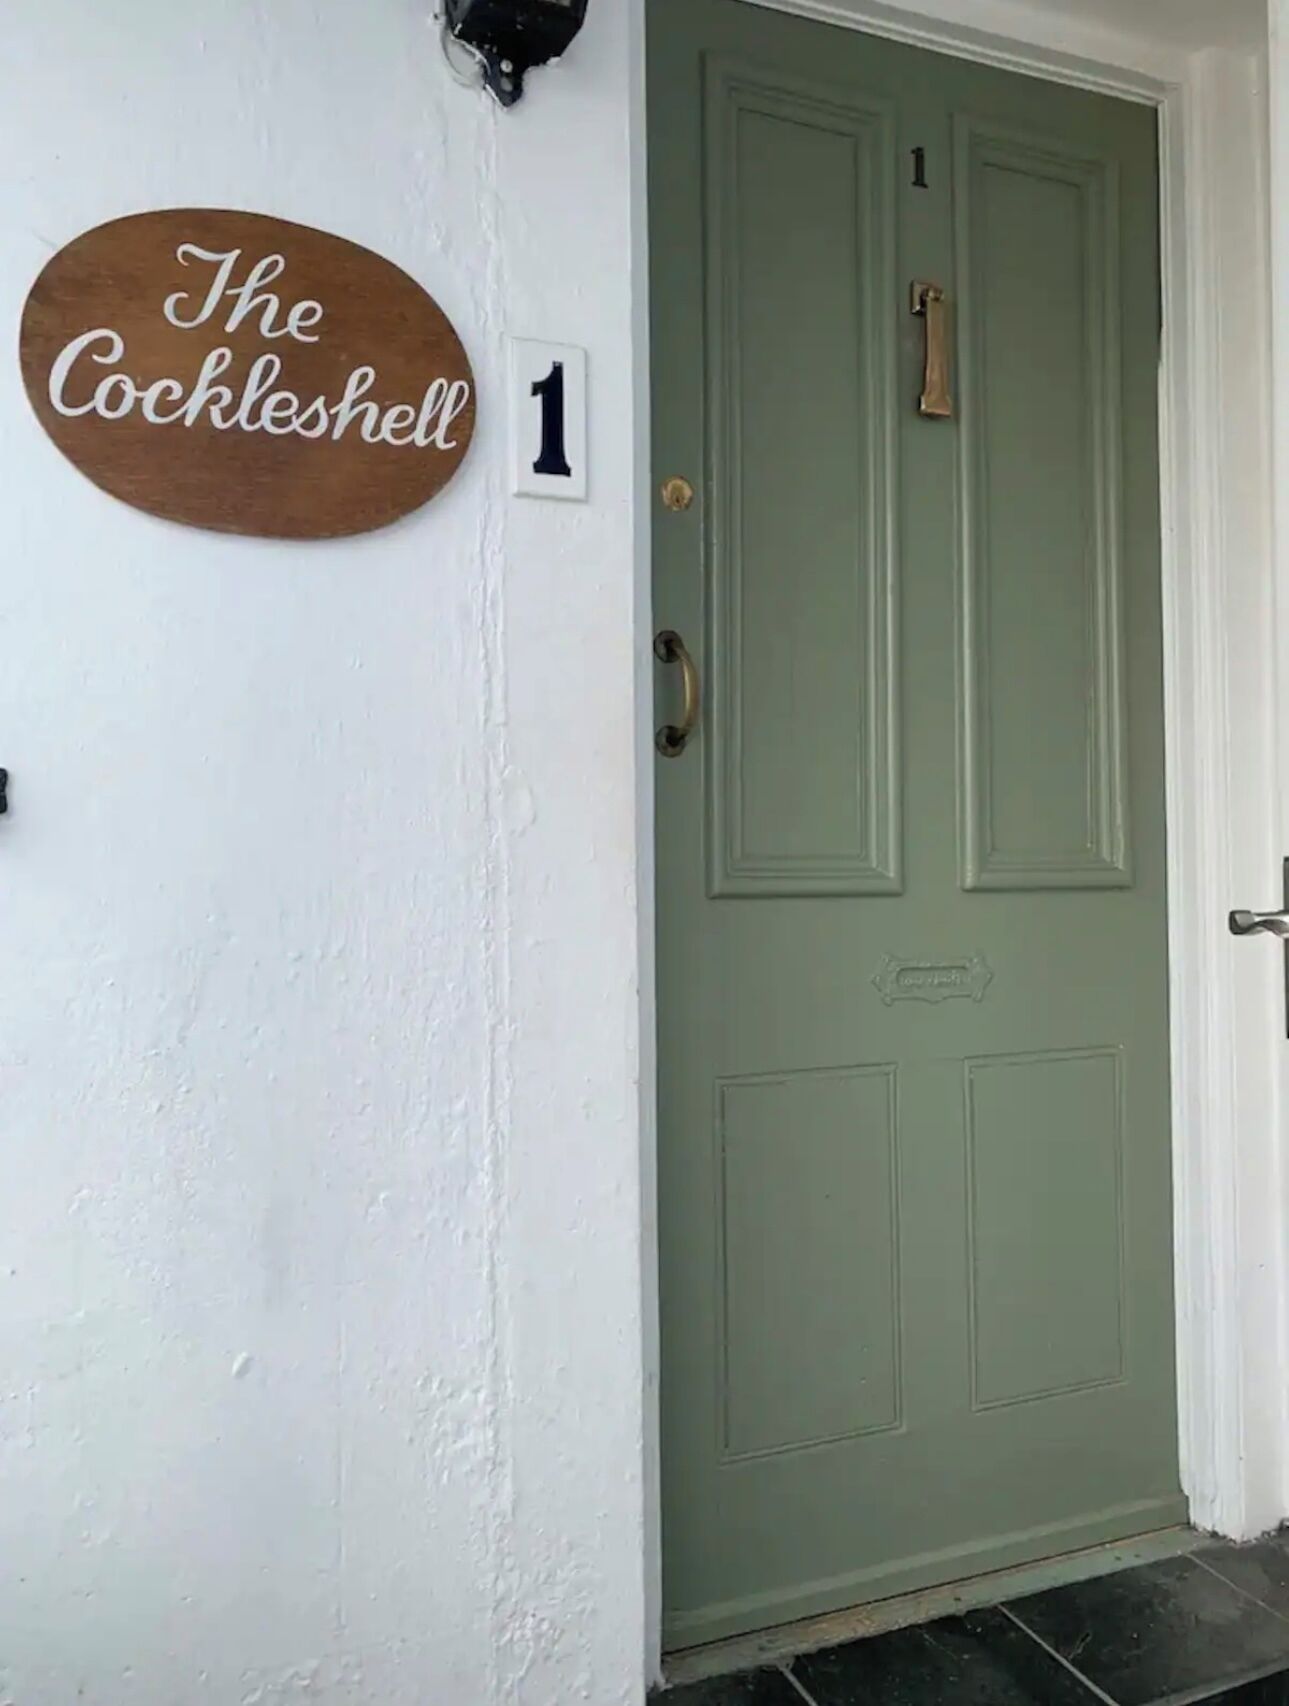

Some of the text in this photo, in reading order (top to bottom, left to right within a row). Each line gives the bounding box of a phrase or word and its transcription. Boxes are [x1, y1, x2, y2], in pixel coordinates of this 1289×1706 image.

[910, 147, 929, 189] 1
[164, 243, 323, 342] The
[48, 329, 470, 450] Cockleshell
[531, 361, 572, 477] 1
